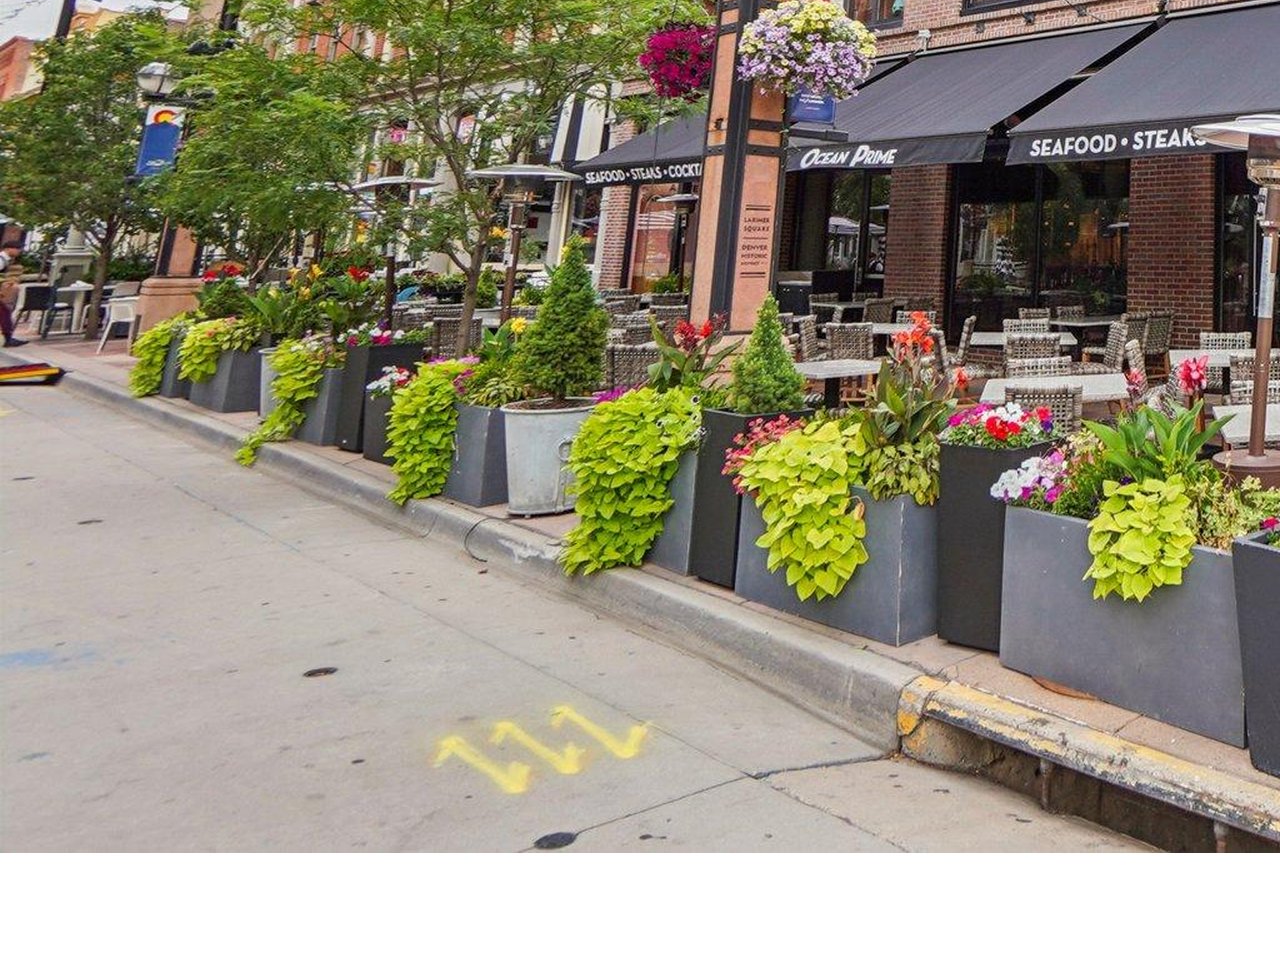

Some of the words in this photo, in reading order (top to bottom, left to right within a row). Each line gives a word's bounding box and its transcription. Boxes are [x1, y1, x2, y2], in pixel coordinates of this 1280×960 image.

[800, 148, 851, 169] OCEAN
[848, 144, 898, 168] PRIME
[1029, 134, 1117, 157] SEAFOOD
[585, 170, 626, 184] SEAFOOD
[630, 167, 662, 181] STEAKS
[668, 162, 703, 178] COCKT
